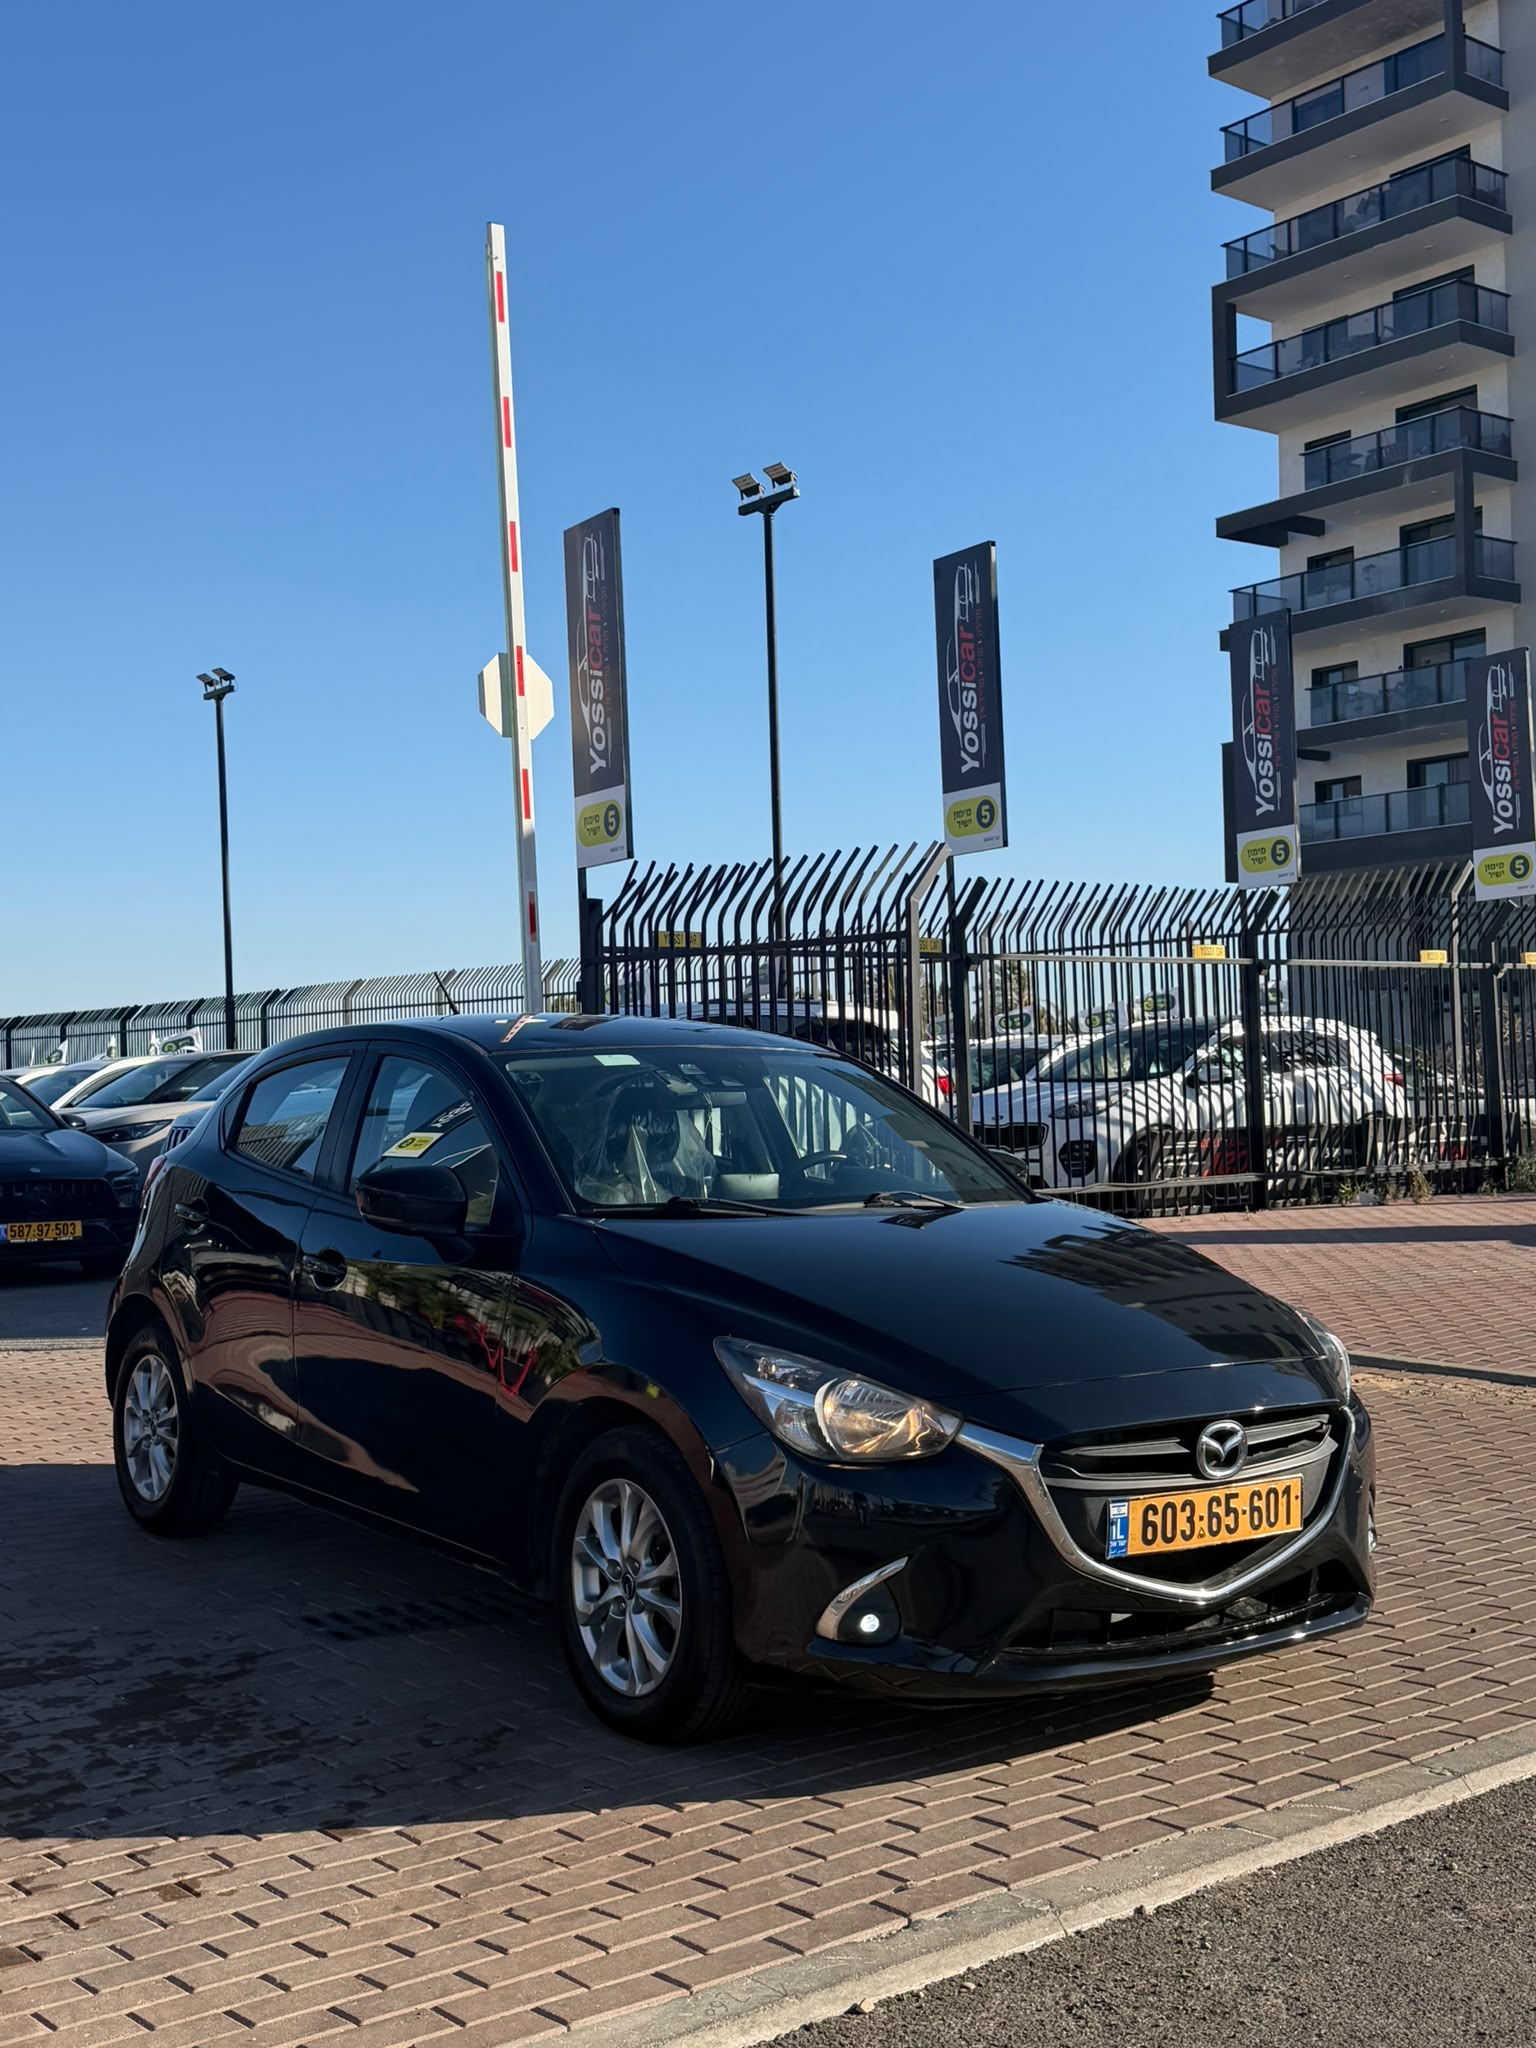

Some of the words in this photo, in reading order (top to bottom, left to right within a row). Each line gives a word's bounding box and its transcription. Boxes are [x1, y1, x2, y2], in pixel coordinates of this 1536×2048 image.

[587, 605, 607, 775] Yossicar
[959, 625, 980, 774] Yossicar
[1254, 683, 1275, 816] Yossicar
[1492, 714, 1513, 834] Yossicar
[608, 810, 616, 832] 5
[981, 805, 990, 824] 5
[1276, 844, 1284, 862] 5
[1515, 859, 1524, 875] 5
